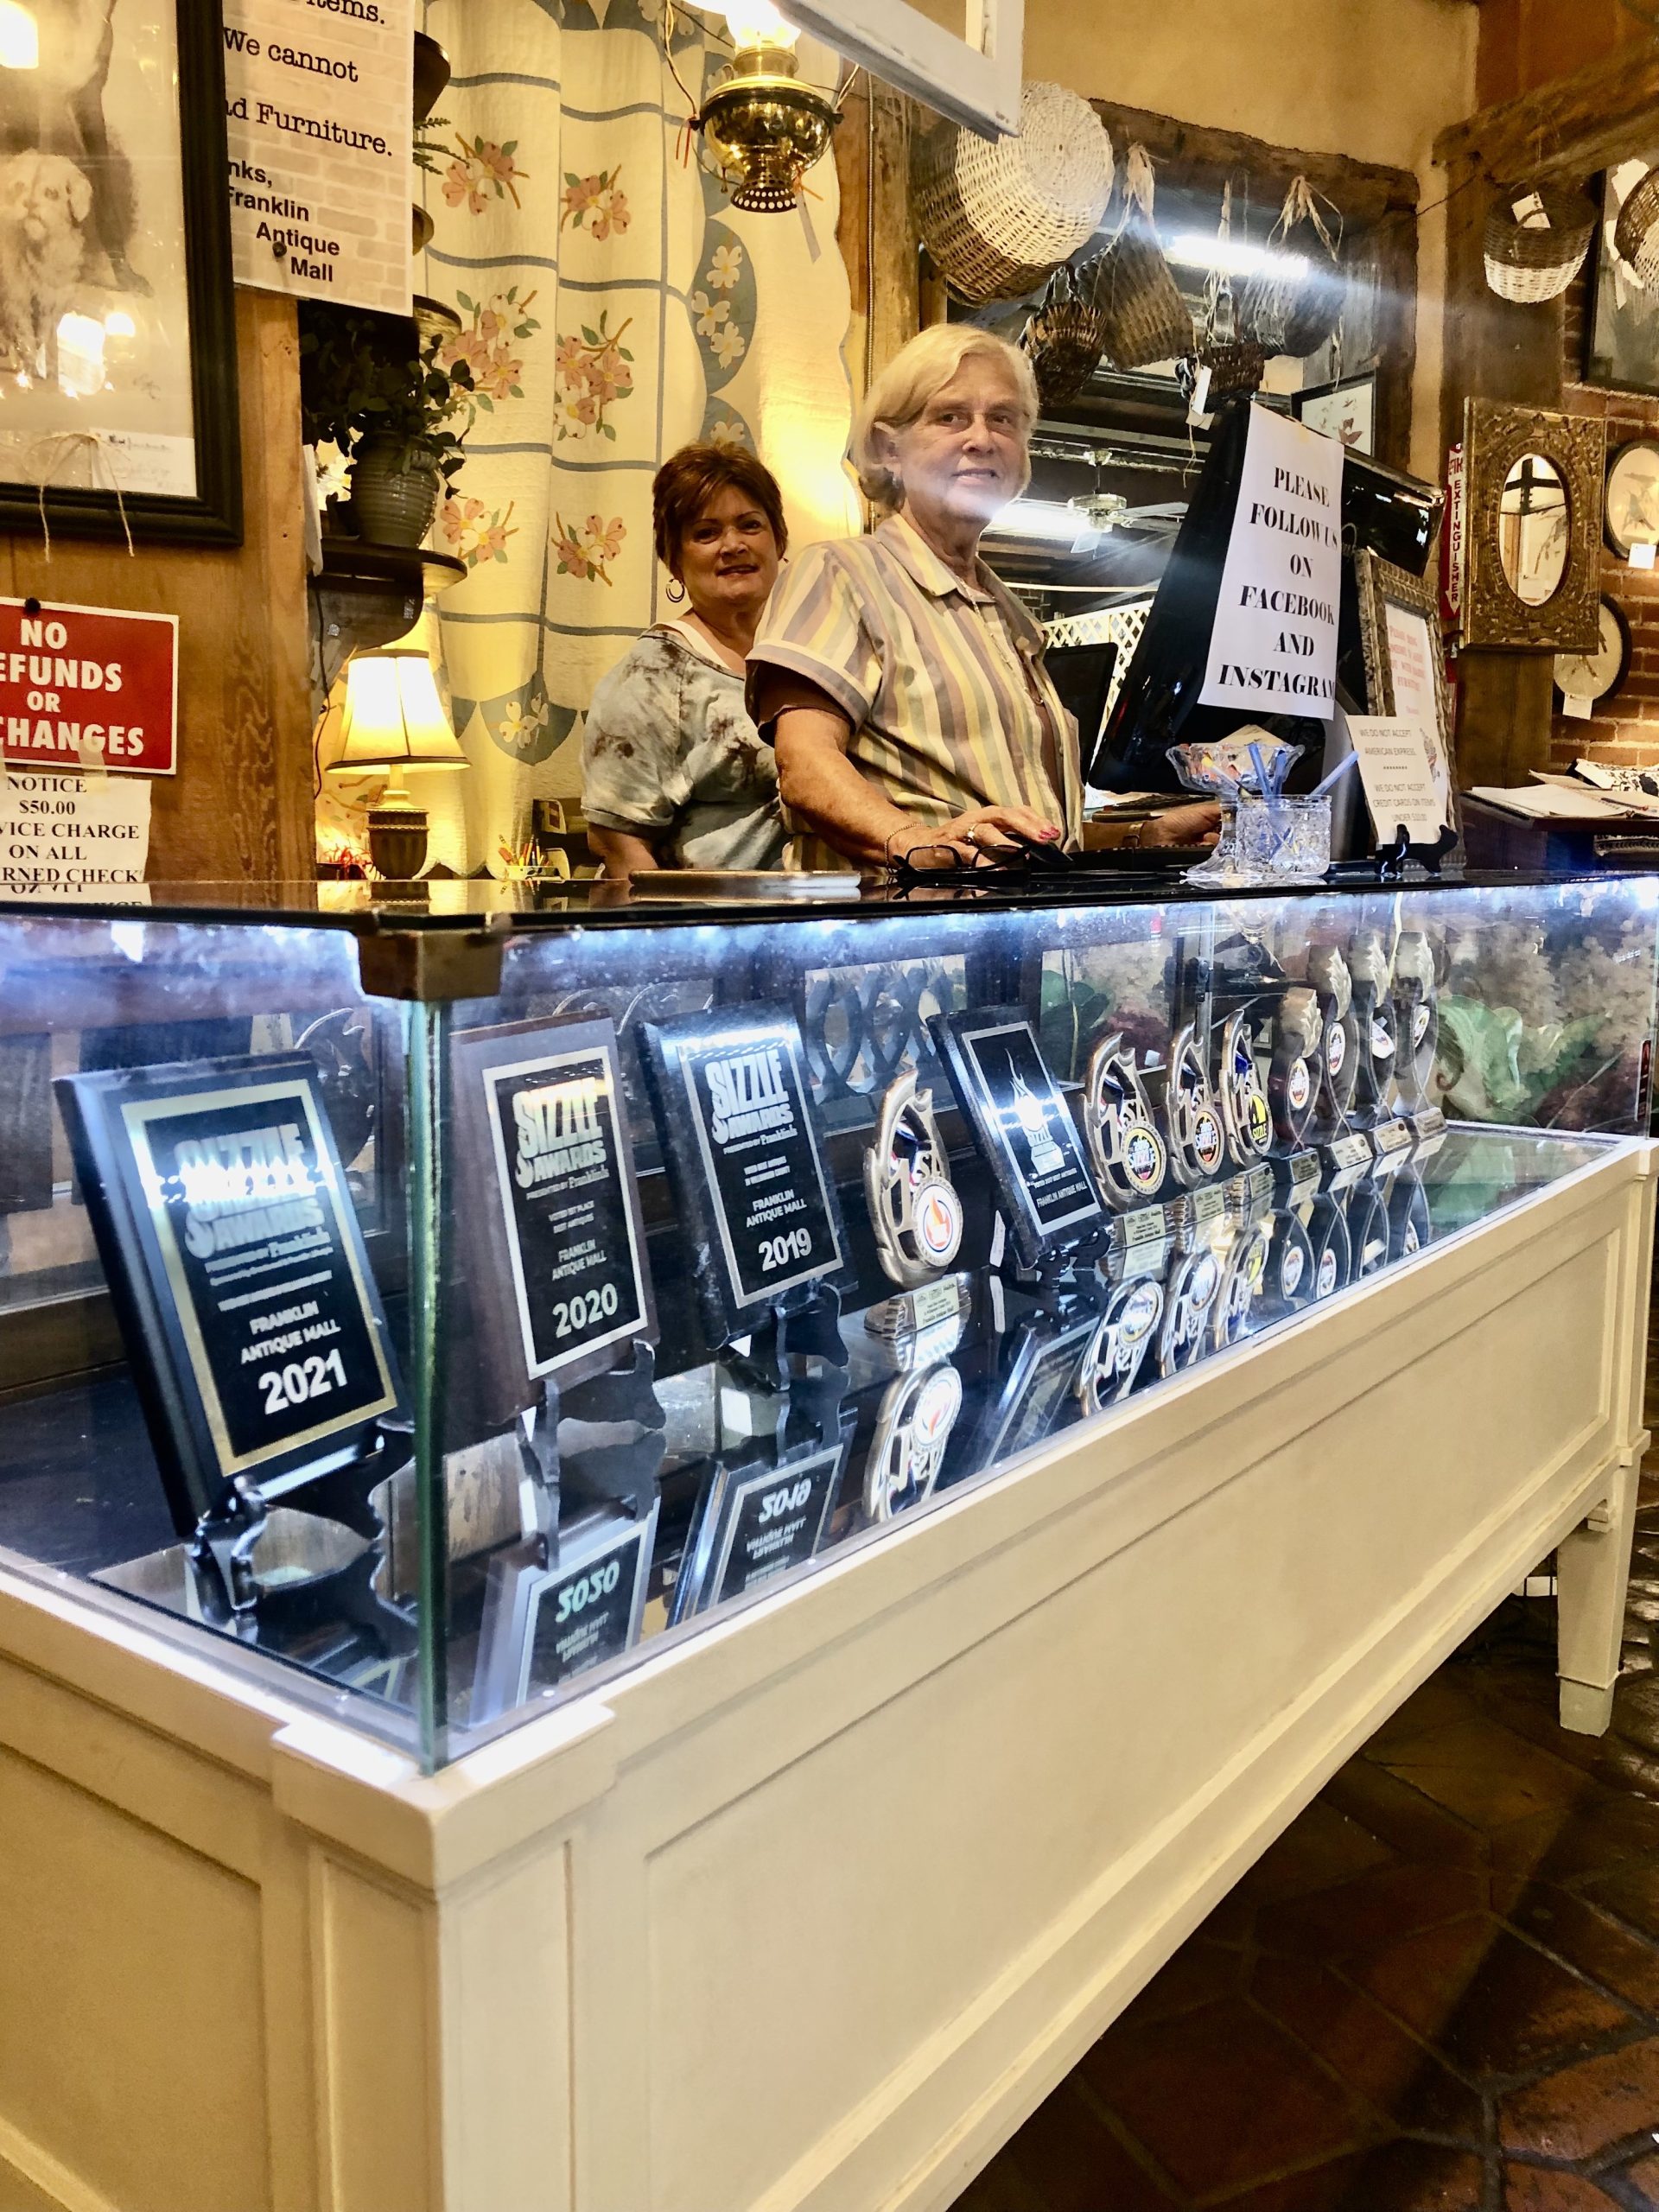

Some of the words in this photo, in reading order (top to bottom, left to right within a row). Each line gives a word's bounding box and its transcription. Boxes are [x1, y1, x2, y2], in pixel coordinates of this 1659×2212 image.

[305, 0, 385, 24] tems.
[223, 27, 260, 56] We
[268, 44, 359, 82] cannot
[256, 102, 392, 156] Furniture.
[256, 221, 340, 257] Antique
[290, 257, 334, 282] Mall
[1274, 467, 1330, 507] PLEASE
[1249, 502, 1320, 542] FOLLOW
[1323, 524, 1338, 550] US
[1451, 480, 1462, 602] EXTINGUISHER
[1290, 554, 1313, 578] ON
[1238, 585, 1335, 626] FACEBOOK
[21, 618, 67, 650] NO
[1273, 632, 1314, 657] AND
[26, 690, 61, 713] OR
[0, 716, 144, 757] HANGES
[7, 776, 87, 793] NOTICE
[19, 799, 76, 815] $50.00
[51, 823, 139, 839] CHARGE
[9, 844, 39, 859] ON
[46, 846, 87, 861] ALL
[0, 867, 60, 882] RNED
[67, 868, 143, 883] CHECK
[704, 1047, 790, 1130] SIZZLE
[512, 1077, 603, 1173] SIZZLE
[728, 1103, 794, 1140] AWARDS
[533, 1140, 607, 1183] AWARDS
[747, 1206, 784, 1228] ANTIQUE
[784, 1198, 807, 1214] MALL
[752, 1189, 795, 1211] FRANKLIN
[557, 1239, 597, 1263] FRANKLIN
[758, 1228, 811, 1271] 2019
[551, 1260, 588, 1282] ANTIQUE
[587, 1254, 607, 1270] MALL
[250, 1300, 320, 1336] FRANKLIN
[551, 1282, 619, 1338] 2020
[240, 1331, 305, 1364] ANTIQUE
[303, 1319, 341, 1344] MALL
[258, 1348, 347, 1415] 2021
